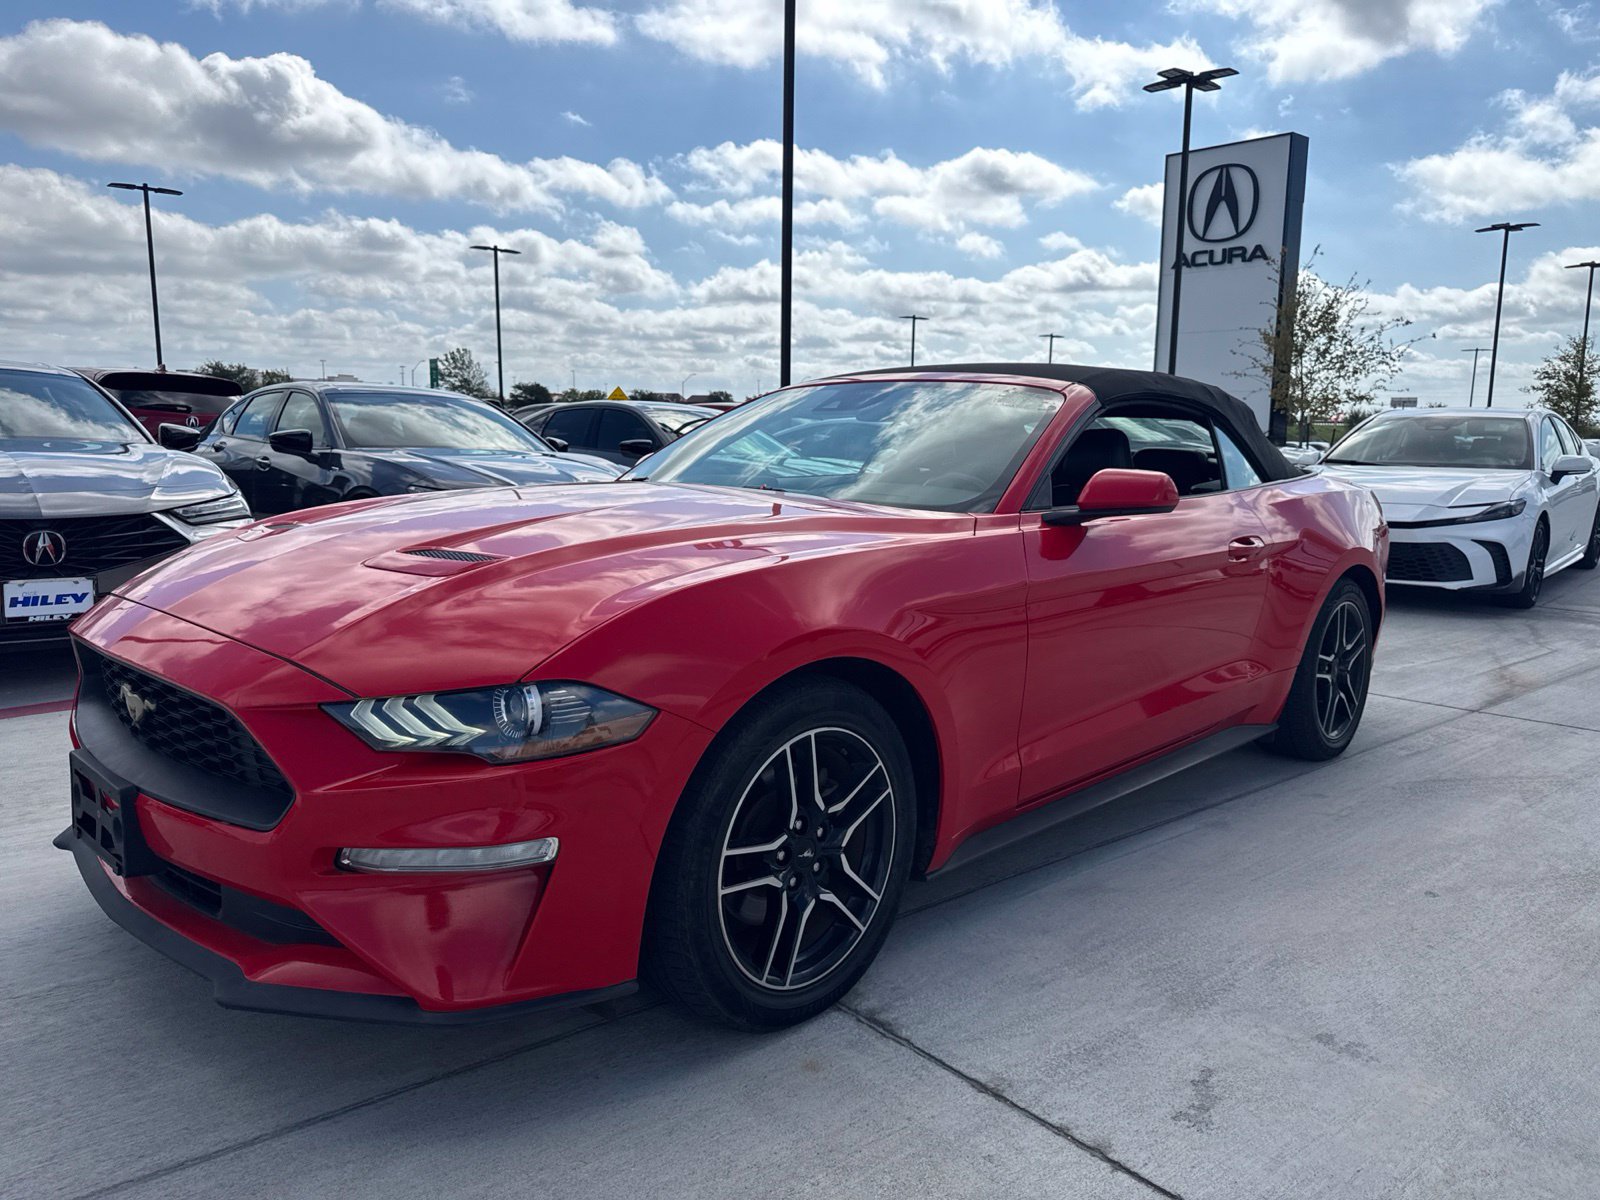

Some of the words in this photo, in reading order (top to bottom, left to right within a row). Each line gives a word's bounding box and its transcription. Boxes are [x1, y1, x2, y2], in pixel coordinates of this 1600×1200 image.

[1171, 244, 1269, 269] ACURA
[9, 592, 89, 608] HILEY
[28, 613, 72, 622] HILEY
